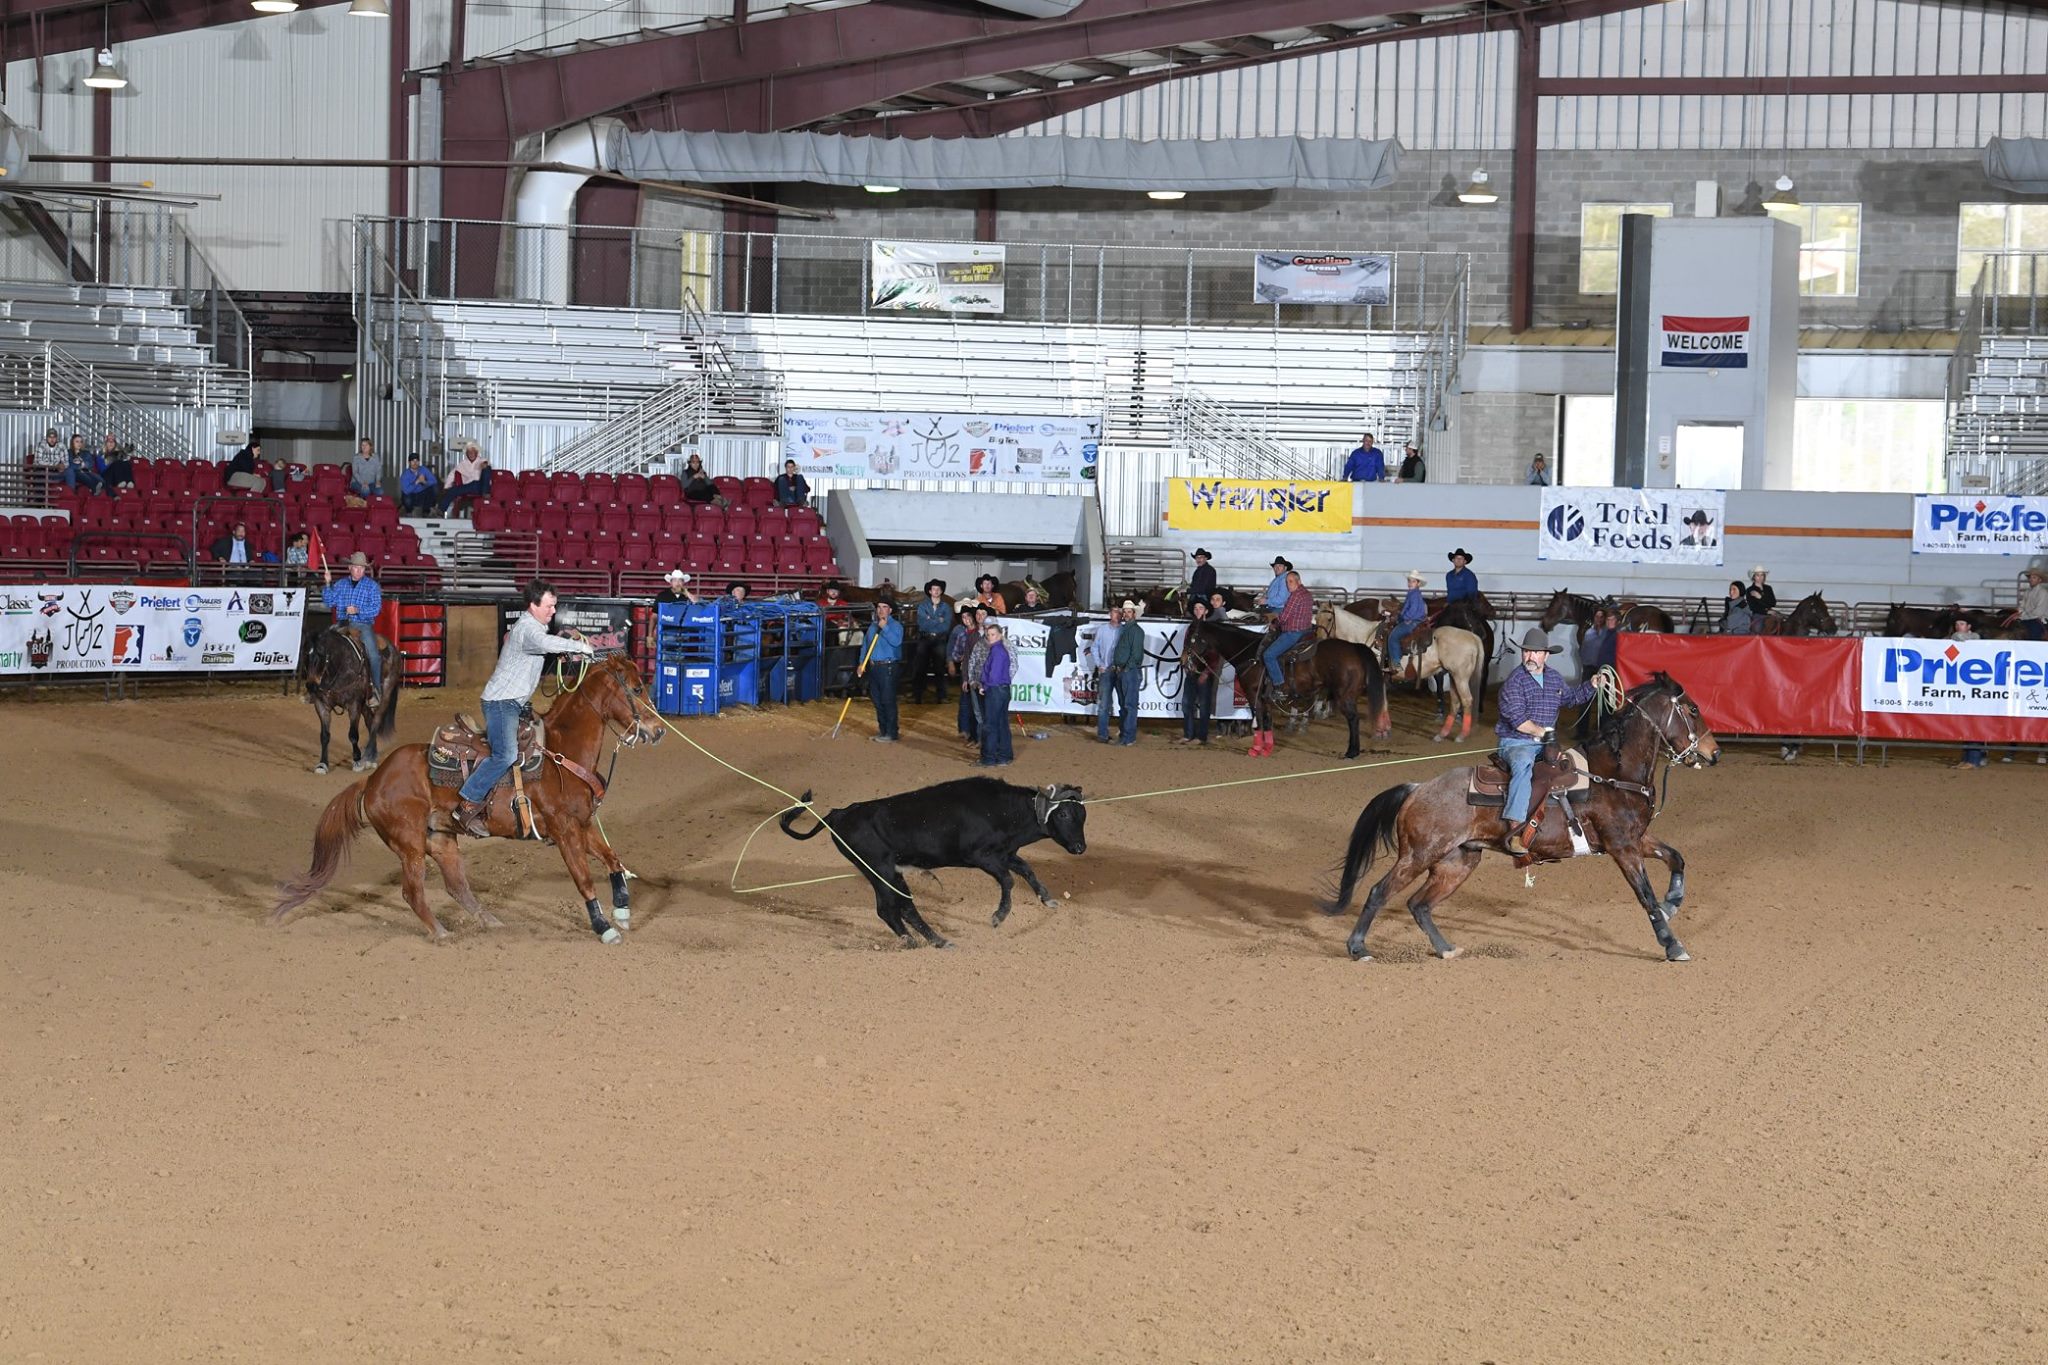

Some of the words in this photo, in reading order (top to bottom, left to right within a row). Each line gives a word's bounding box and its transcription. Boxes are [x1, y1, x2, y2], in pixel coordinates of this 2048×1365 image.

[1293, 256, 1352, 266] Carolina
[1667, 333, 1743, 350] WELCOME
[903, 470, 966, 478] PRODUCTIONS
[1185, 480, 1331, 526] Wrangler
[1596, 502, 1668, 525] Total
[1931, 500, 2048, 532] Priefe
[1592, 527, 1672, 550] Feeds
[1957, 532, 1990, 543] Farm,
[1994, 532, 2029, 542] Ranch
[140, 594, 181, 609] Priefert
[56, 660, 106, 669] PRODUCTIONS
[1884, 644, 2048, 687] Priefe
[1873, 699, 1934, 707] 1-800-57-8616
[1921, 686, 1966, 700] Farm,
[2025, 689, 2040, 704] &
